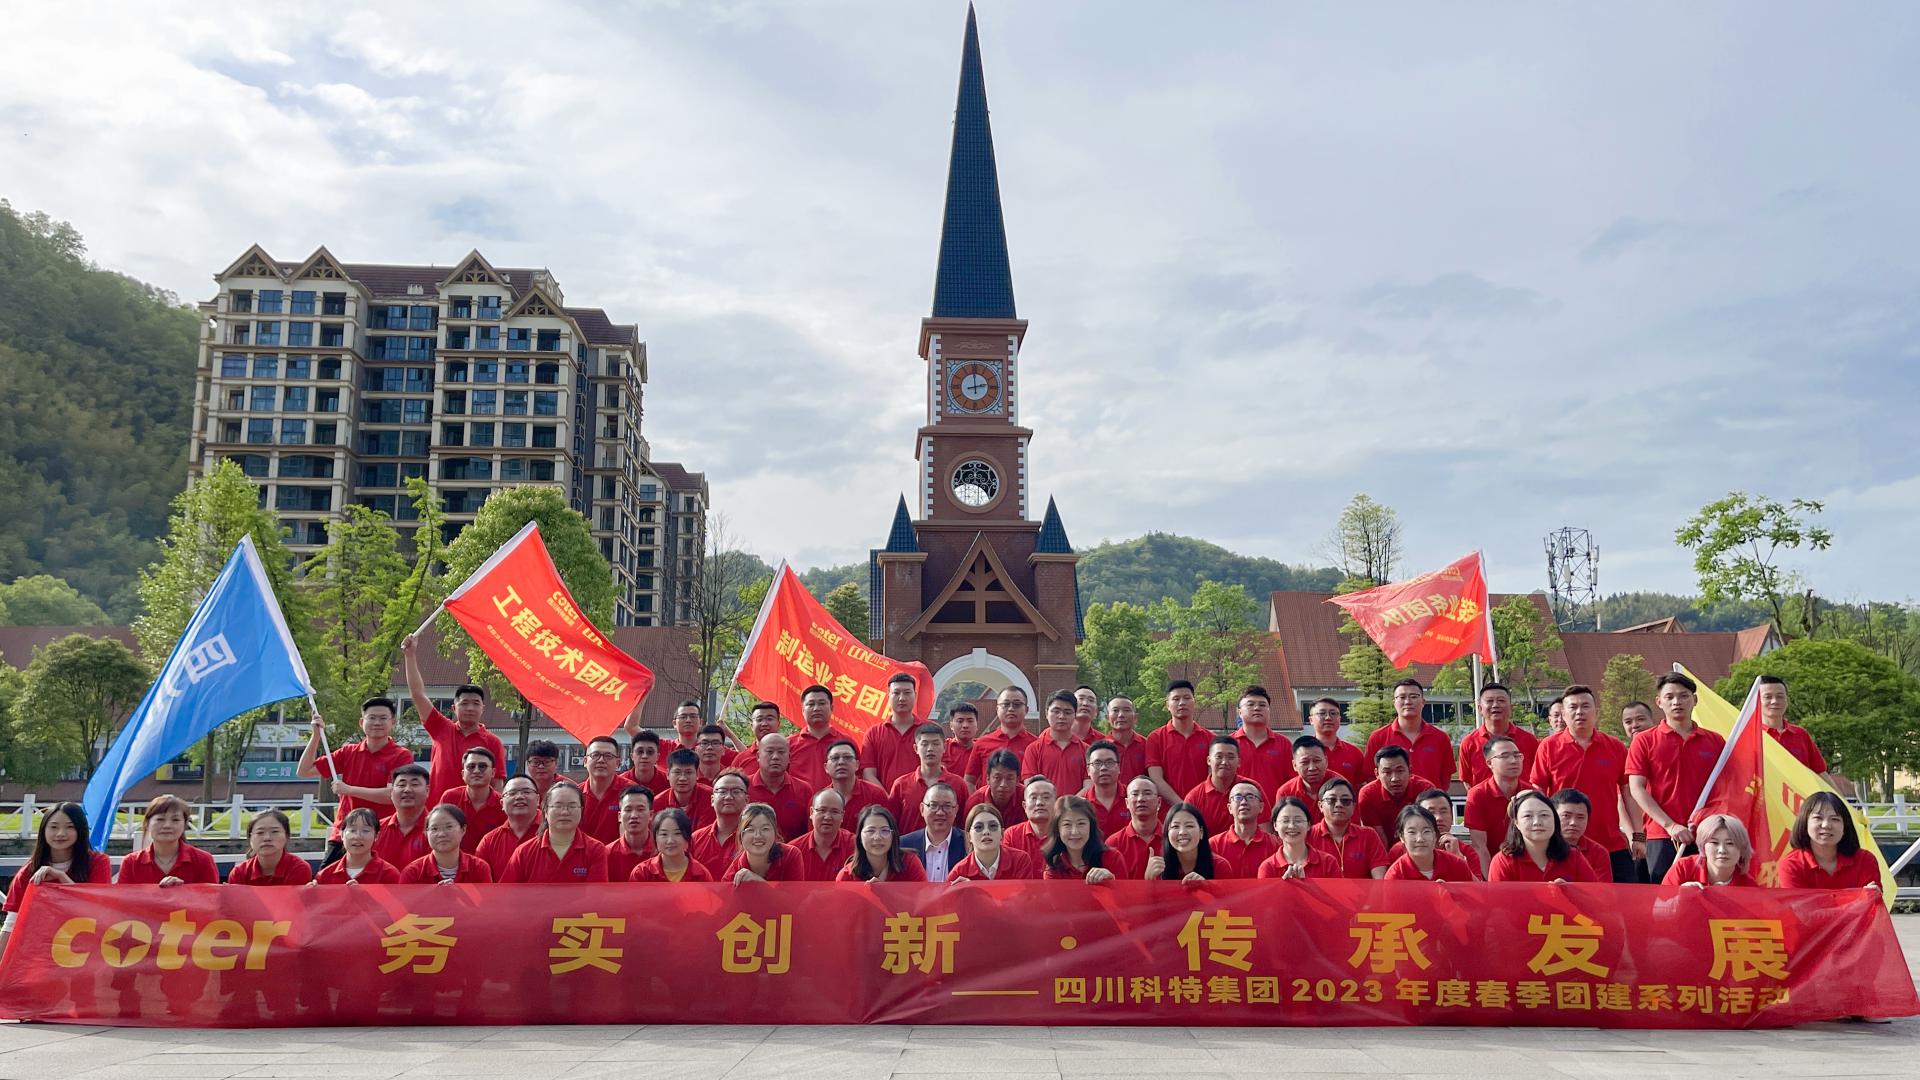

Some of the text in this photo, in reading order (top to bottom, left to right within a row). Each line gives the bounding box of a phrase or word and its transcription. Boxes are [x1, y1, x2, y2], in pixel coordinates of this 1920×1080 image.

[492, 585, 629, 701] 工程技术团队
[775, 629, 895, 720] 制造业务团
[51, 909, 292, 971] coter
